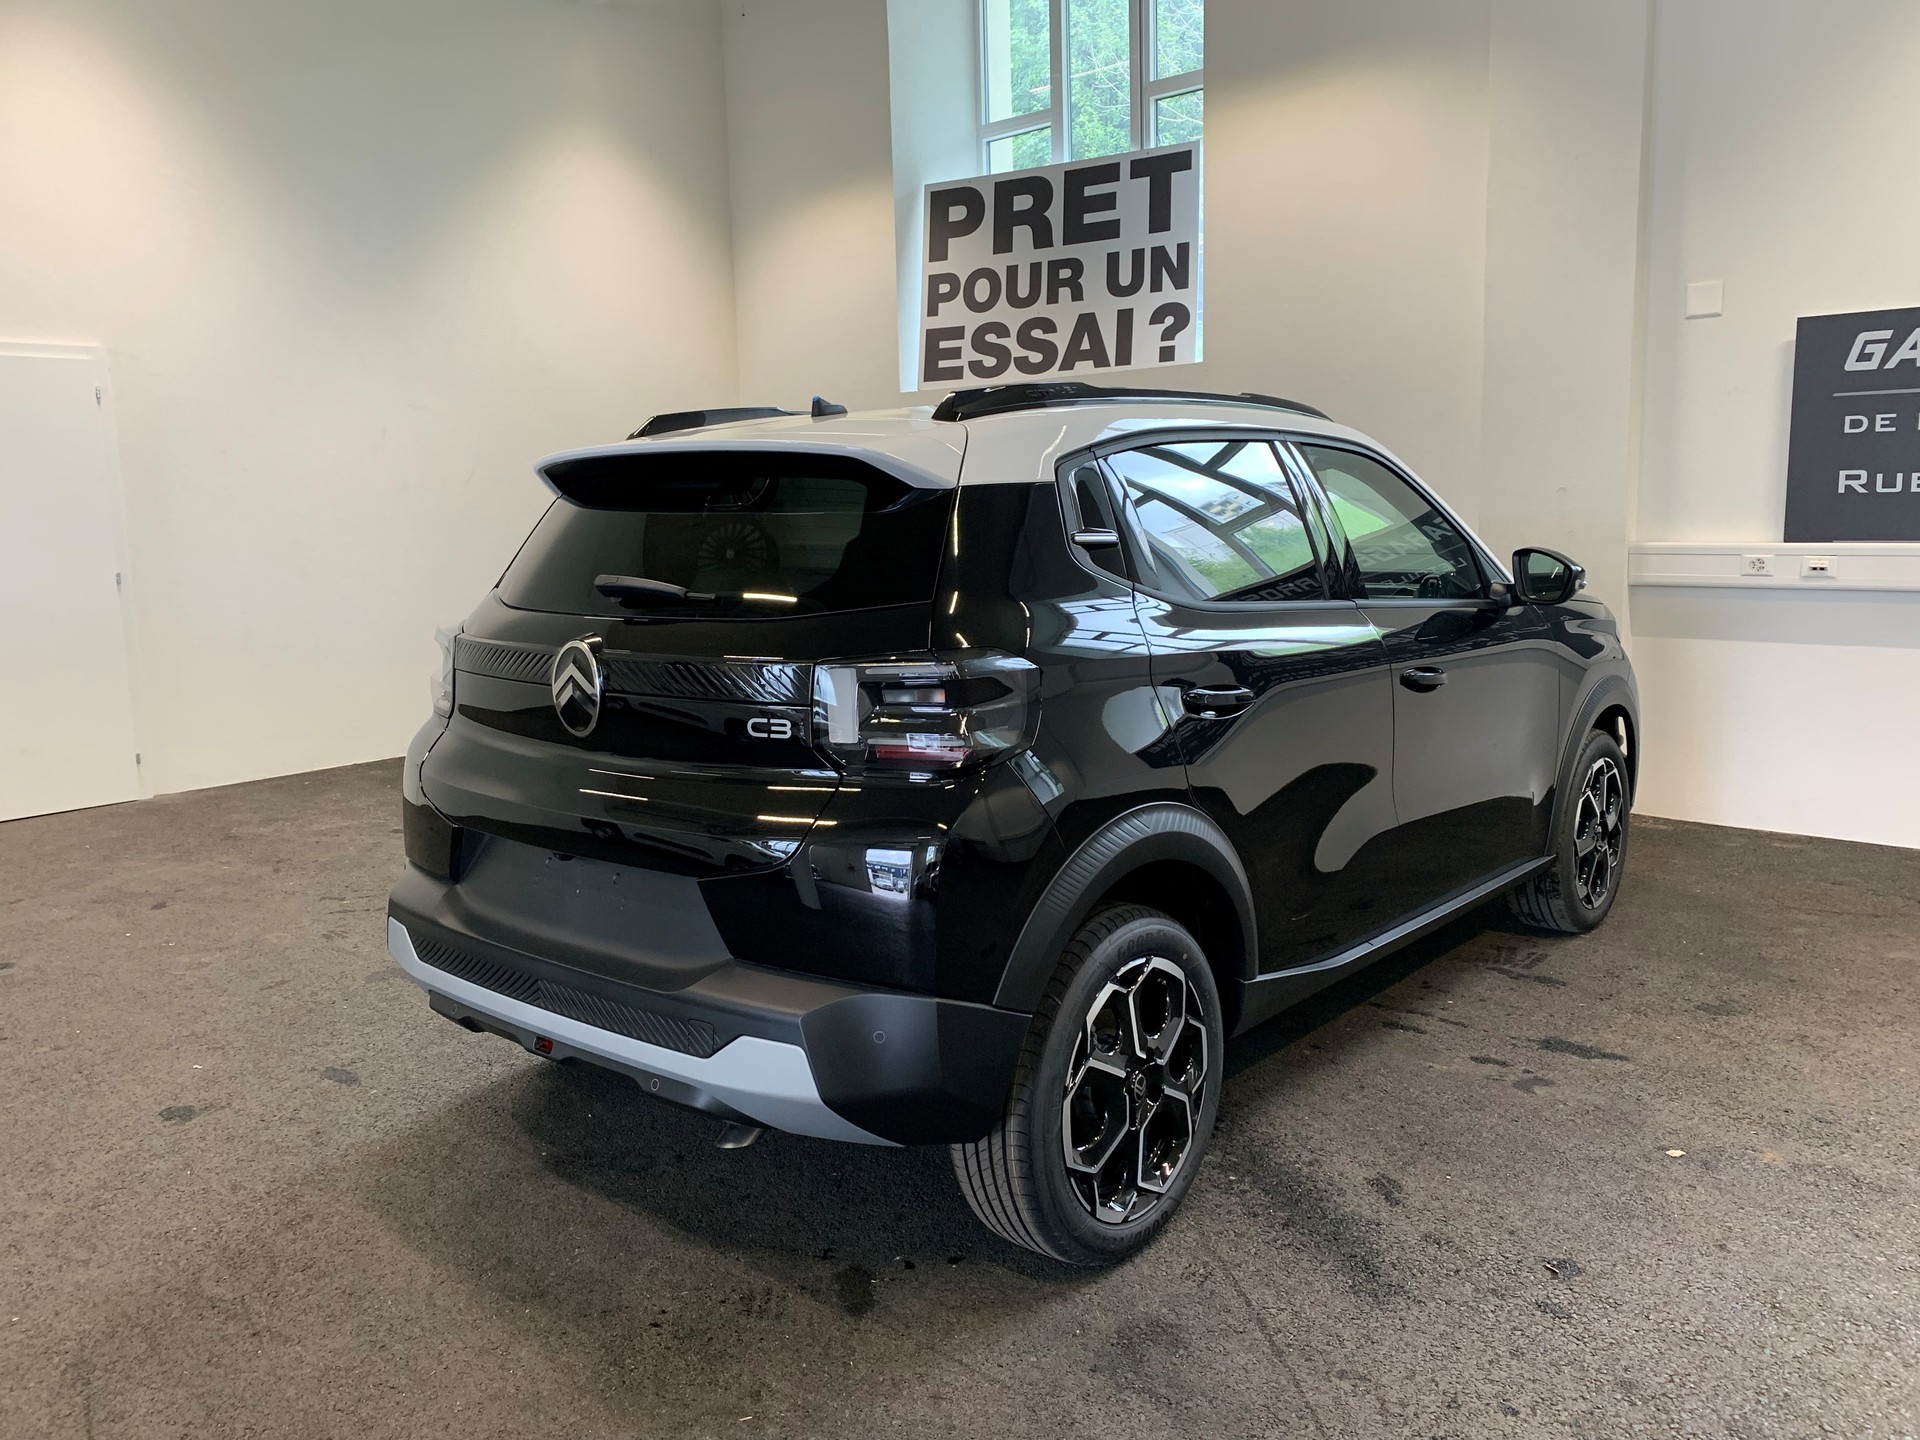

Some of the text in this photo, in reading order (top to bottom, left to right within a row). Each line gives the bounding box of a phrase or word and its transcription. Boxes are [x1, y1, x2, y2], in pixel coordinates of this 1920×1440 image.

[928, 149, 1193, 263] PRET
[926, 242, 1190, 317] POUR UN
[923, 302, 1191, 382] ESSAI ?
[1843, 413, 1897, 434] DE
[747, 717, 792, 739] C3
